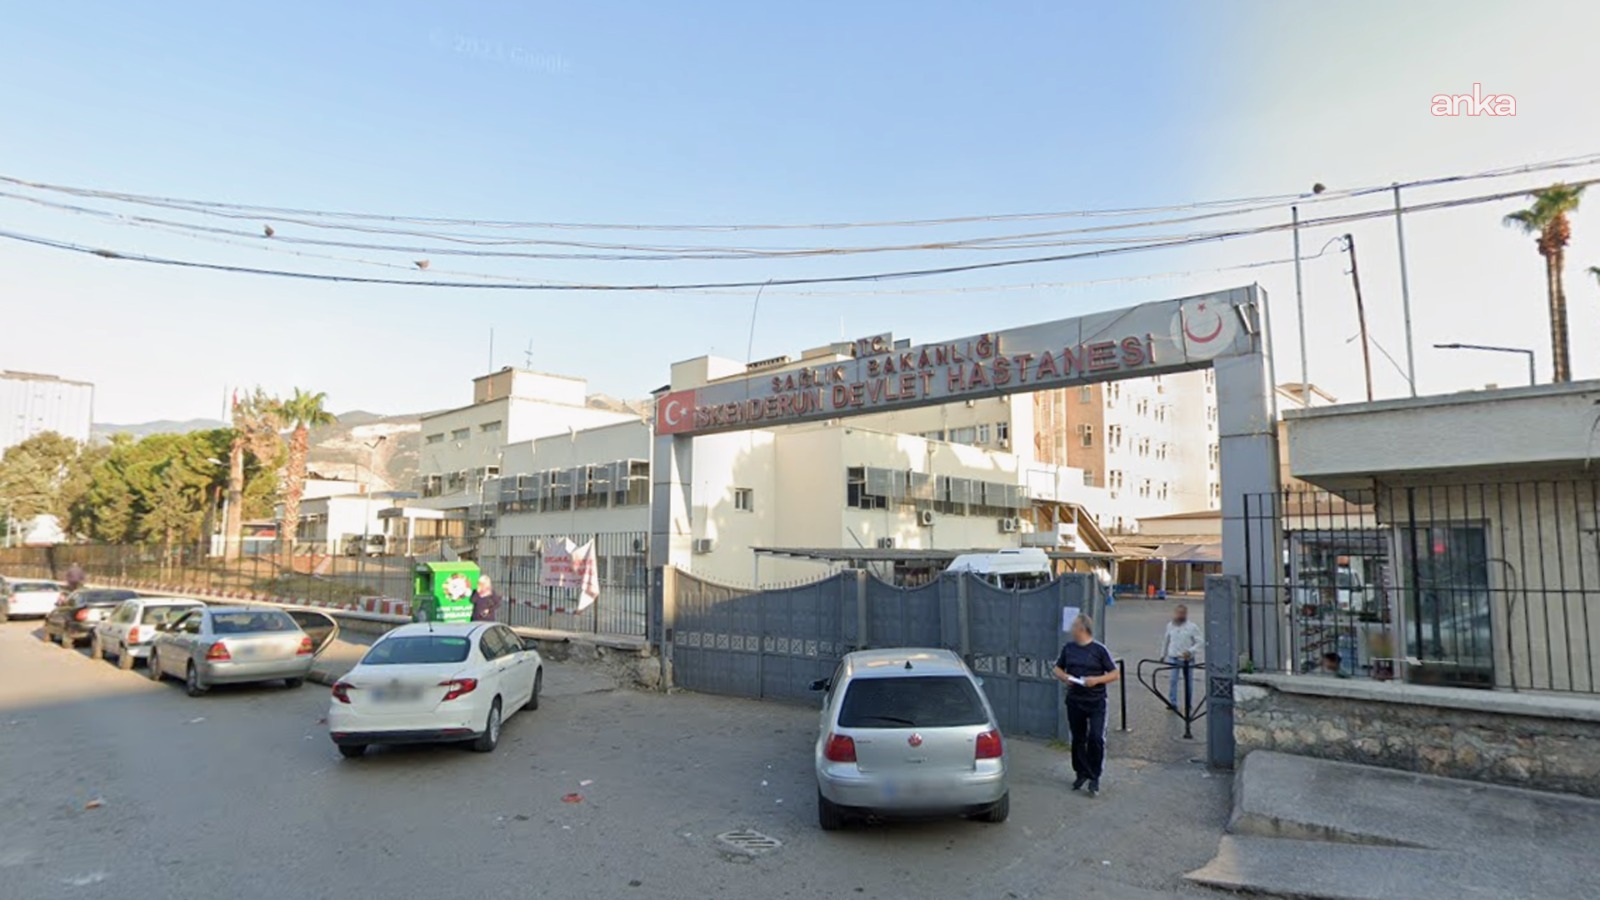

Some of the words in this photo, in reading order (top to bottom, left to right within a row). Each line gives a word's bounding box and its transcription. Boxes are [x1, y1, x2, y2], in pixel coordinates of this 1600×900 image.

[694, 387, 826, 428] İSKENDERUN
[832, 369, 936, 409] DEVLET
[946, 332, 1157, 393] HASTANESİ
[771, 364, 845, 393] SAĞLIK
[866, 333, 1003, 378] BAKANLIĞI
